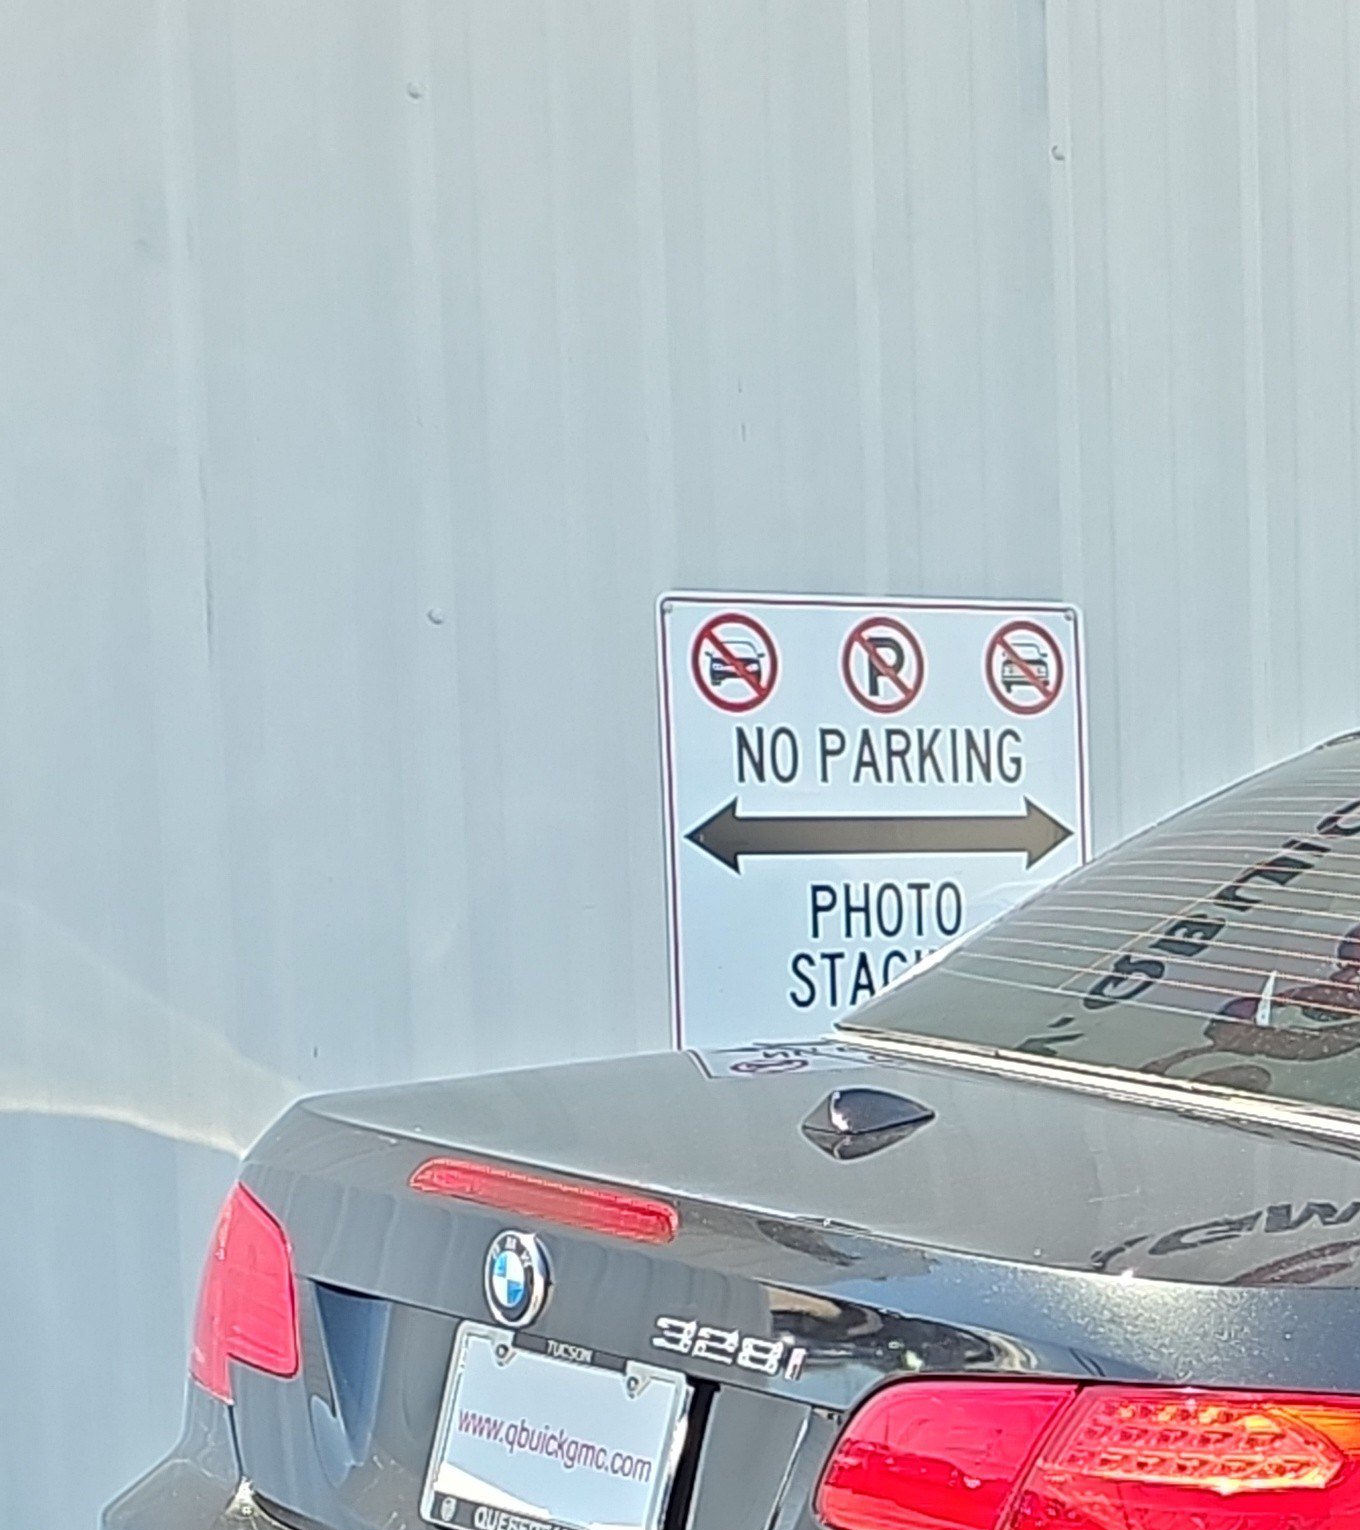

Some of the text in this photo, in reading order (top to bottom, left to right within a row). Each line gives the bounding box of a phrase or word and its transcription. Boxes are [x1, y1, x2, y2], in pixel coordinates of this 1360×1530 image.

[736, 727, 1023, 784] NO PARKING
[811, 882, 962, 938] PHOTO
[546, 1339, 593, 1364] TUCSON
[457, 1408, 652, 1483] www.qbuickgmc.com
